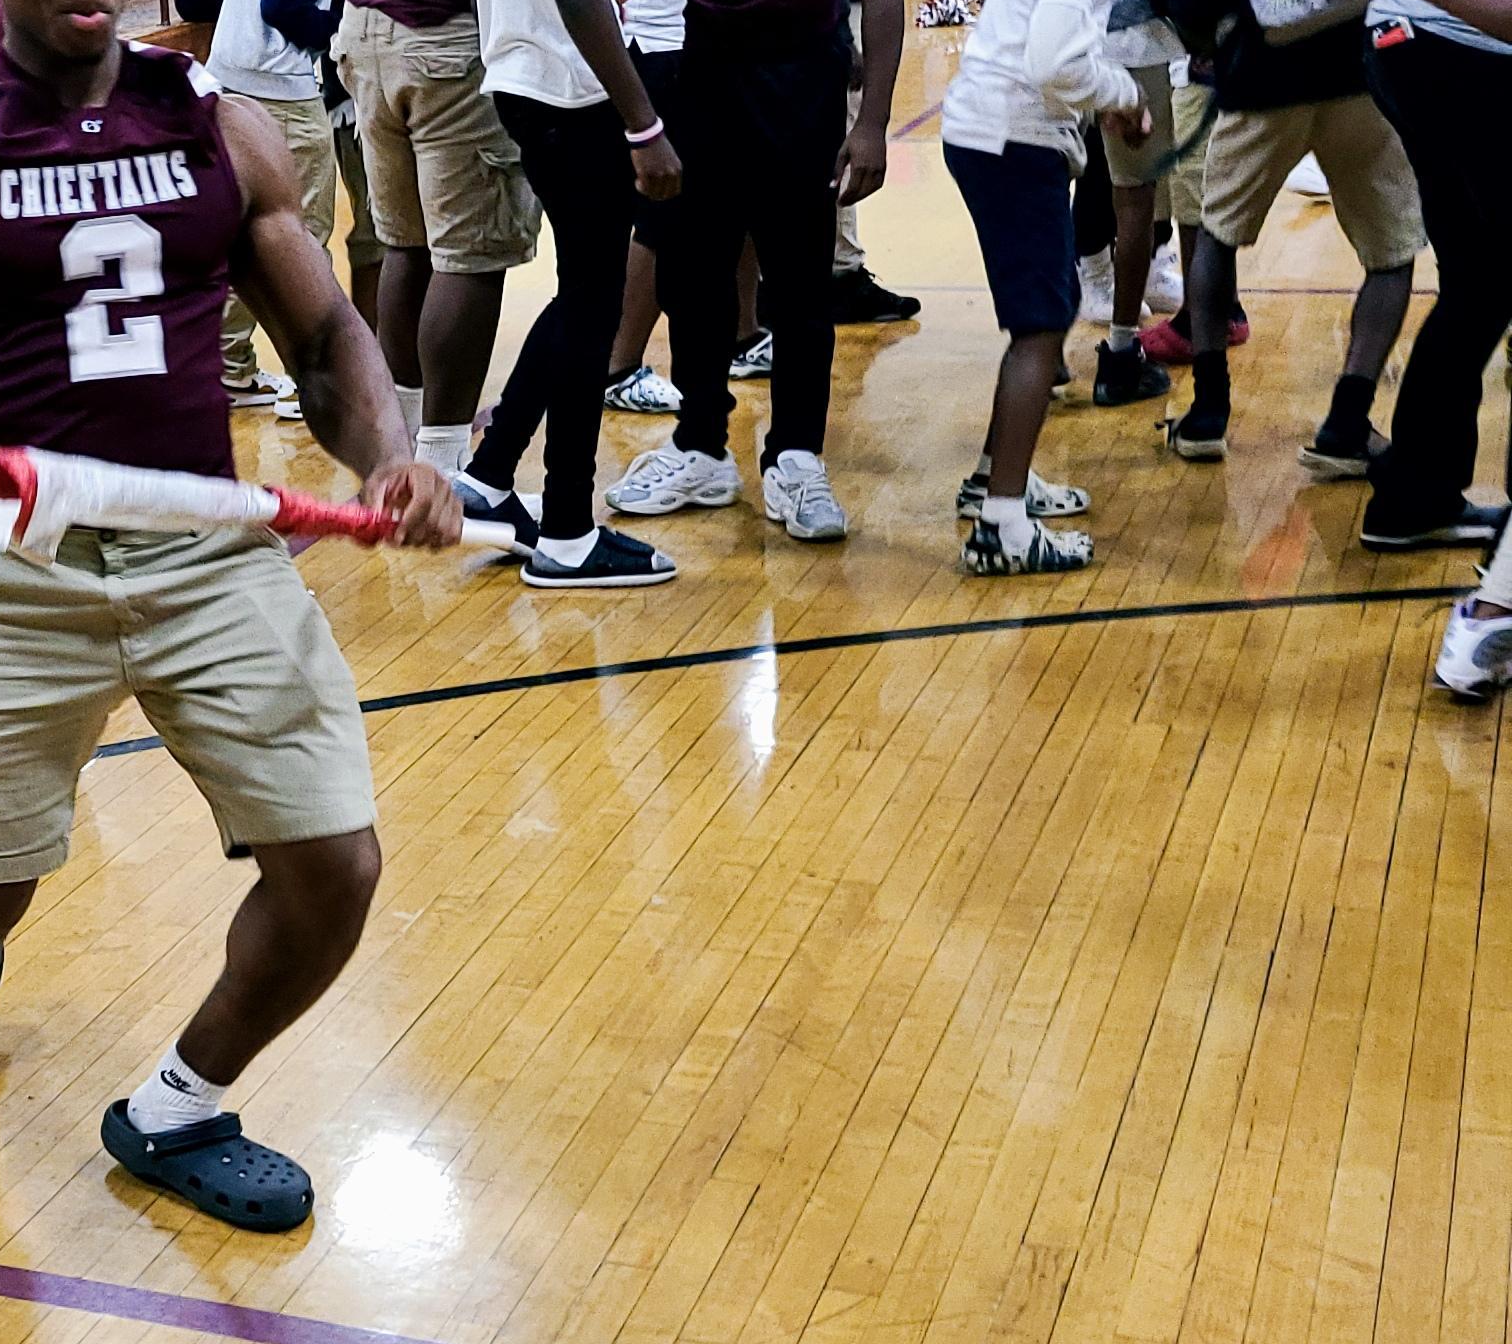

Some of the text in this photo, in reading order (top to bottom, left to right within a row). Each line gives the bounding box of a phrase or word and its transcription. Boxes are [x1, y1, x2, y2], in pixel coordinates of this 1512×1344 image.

[0, 150, 198, 219] CHIEFTAINS
[59, 213, 168, 383] 2
[167, 1069, 191, 1088] NIKE
